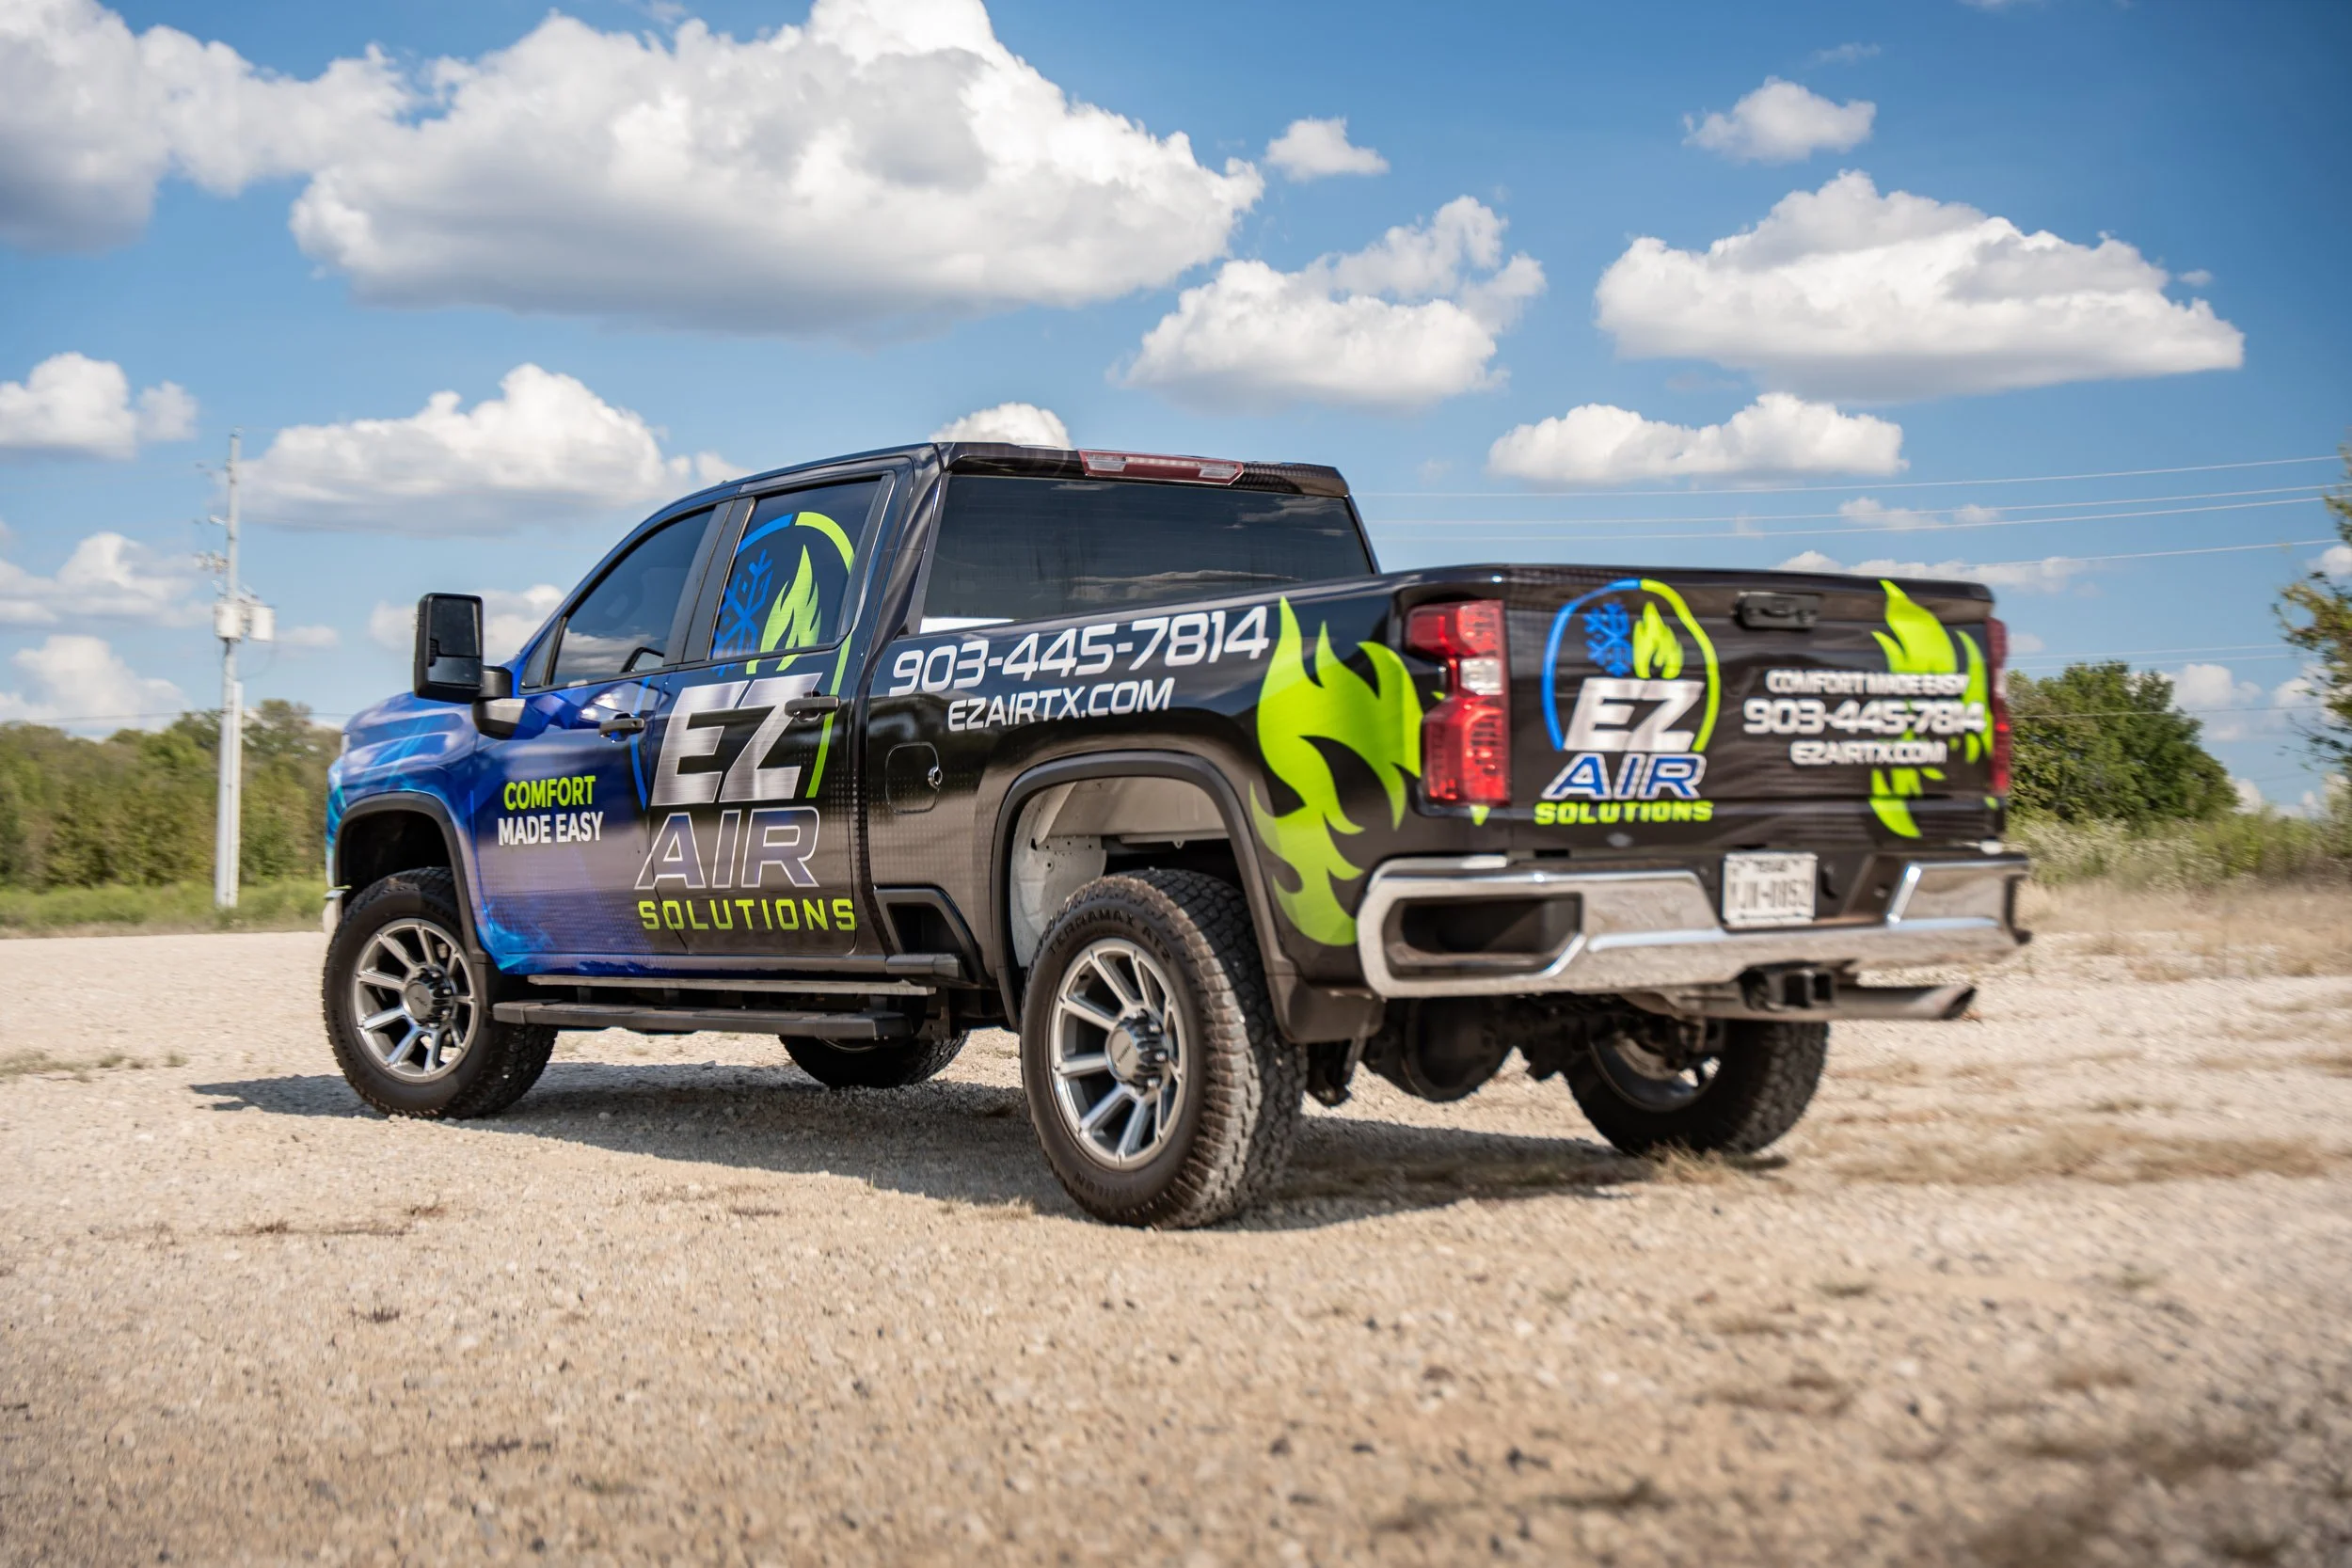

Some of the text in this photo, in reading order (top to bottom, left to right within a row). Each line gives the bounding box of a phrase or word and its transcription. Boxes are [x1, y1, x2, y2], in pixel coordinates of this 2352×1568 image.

[888, 605, 1269, 698] 903-445-7814
[947, 676, 1175, 732] EZAIRTX.COM
[1563, 677, 1706, 752] EZ
[650, 673, 824, 807] EZ
[503, 775, 596, 811] COMFORT
[1540, 752, 1708, 800] AIR
[498, 811, 603, 846] MADE EASY
[1534, 800, 1714, 825] SOLUTIONS
[634, 806, 820, 890] AIR
[637, 898, 857, 931] SOLUTIONS
